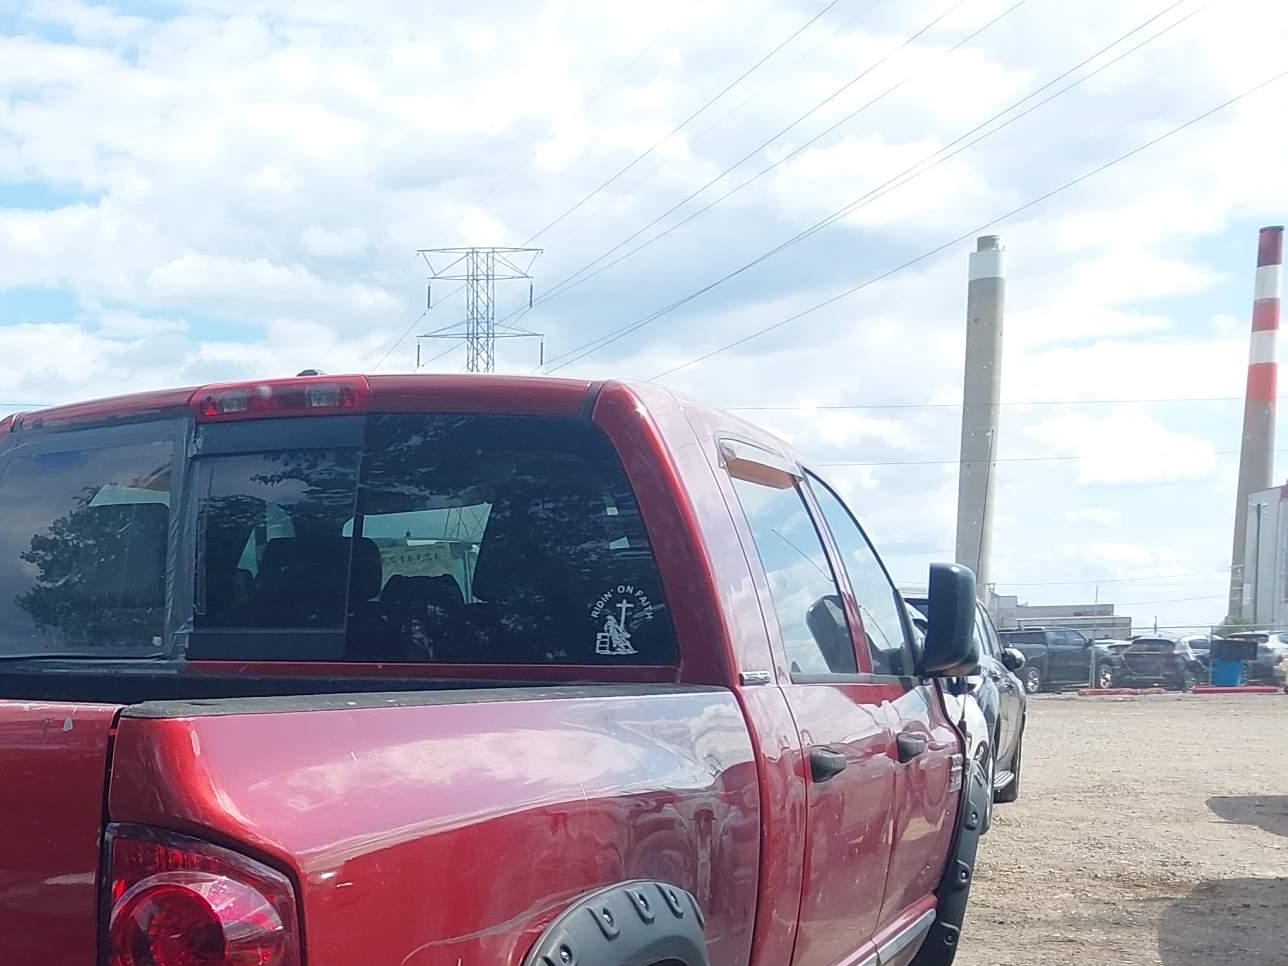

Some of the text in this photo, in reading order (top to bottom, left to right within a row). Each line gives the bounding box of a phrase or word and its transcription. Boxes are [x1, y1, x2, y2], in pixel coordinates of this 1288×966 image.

[591, 585, 654, 619] RIDIN' ON FAITH
